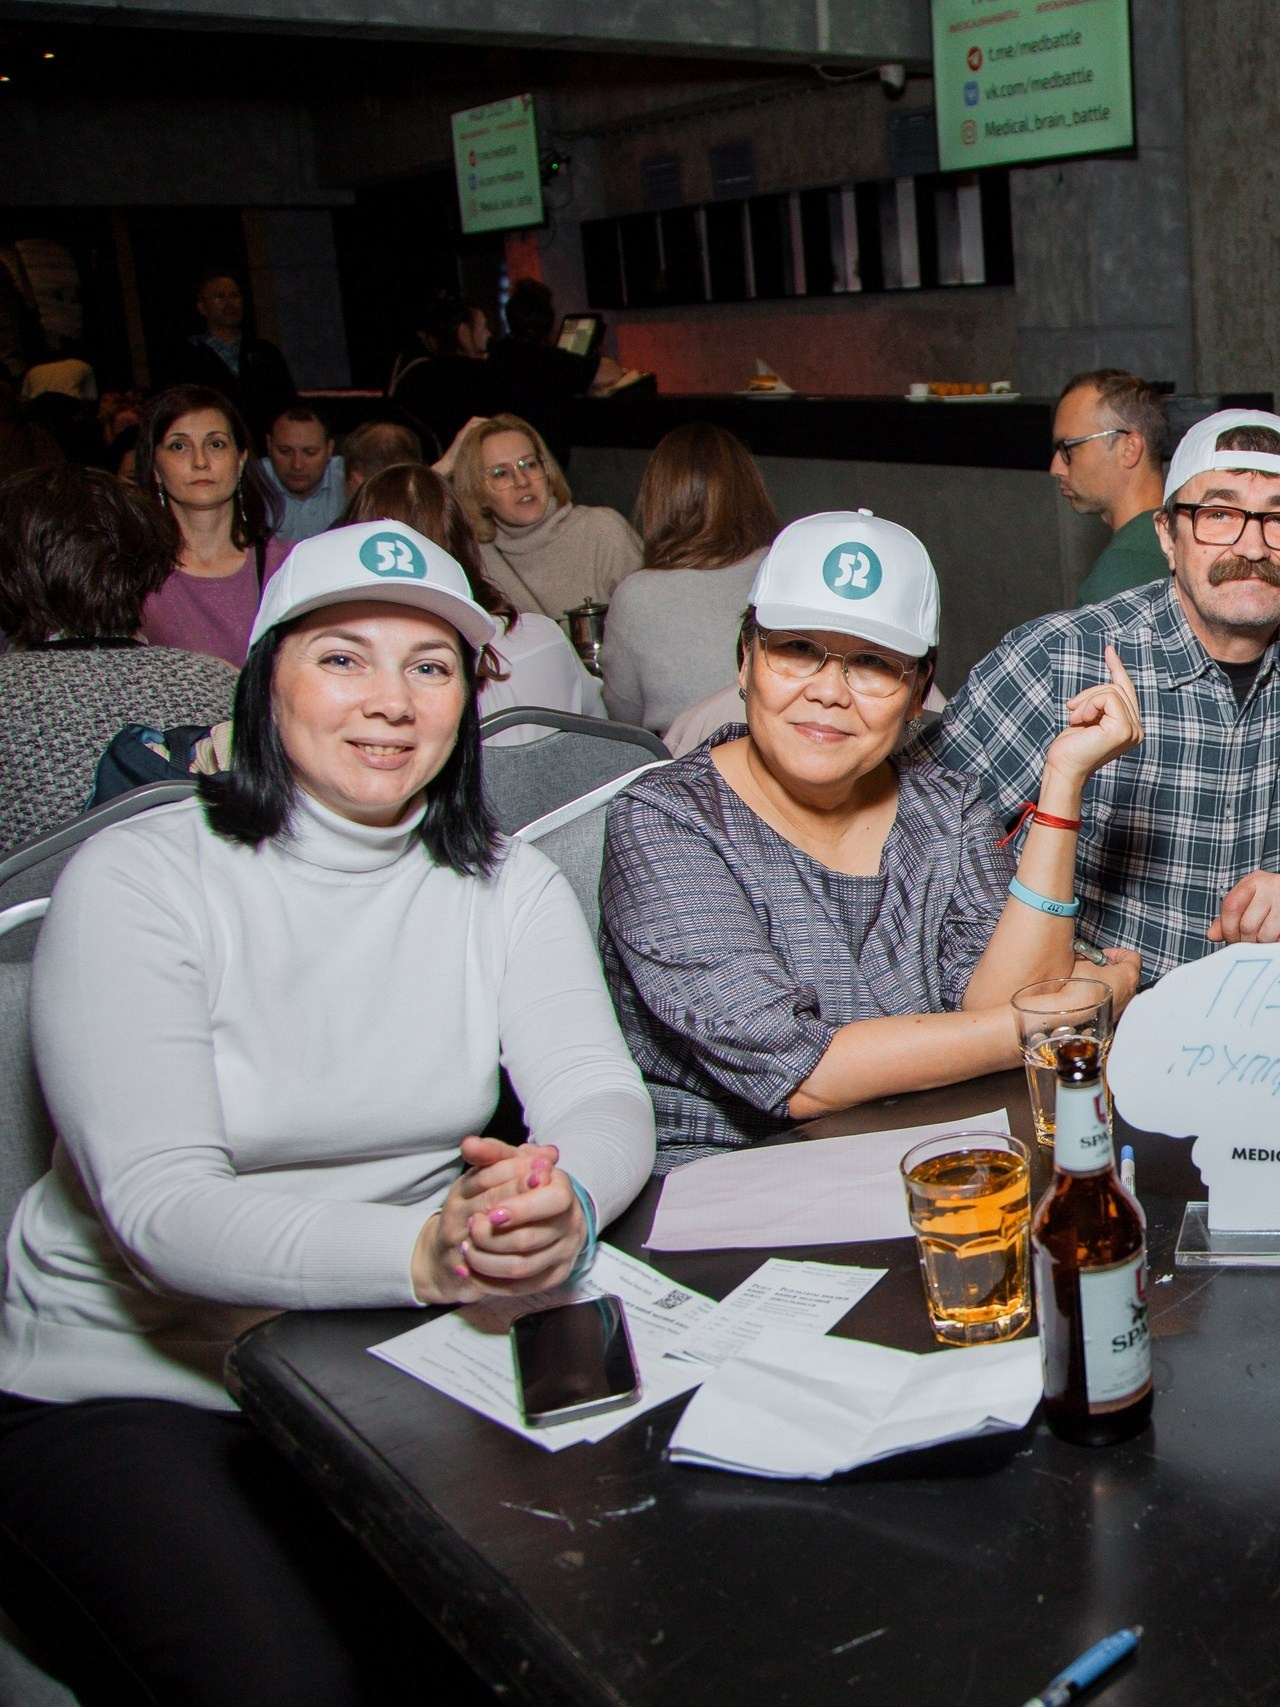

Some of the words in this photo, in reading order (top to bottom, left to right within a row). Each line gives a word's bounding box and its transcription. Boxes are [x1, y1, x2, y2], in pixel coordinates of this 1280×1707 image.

[988, 30, 1083, 62] t.me/medbattle
[984, 67, 1094, 100] vk.com/medbattle
[984, 105, 1111, 137] Medical_brain_battle
[376, 539, 415, 574] 52
[833, 551, 871, 589] 52
[1080, 1131, 1109, 1149] SPA
[1111, 1321, 1149, 1354] SPA
